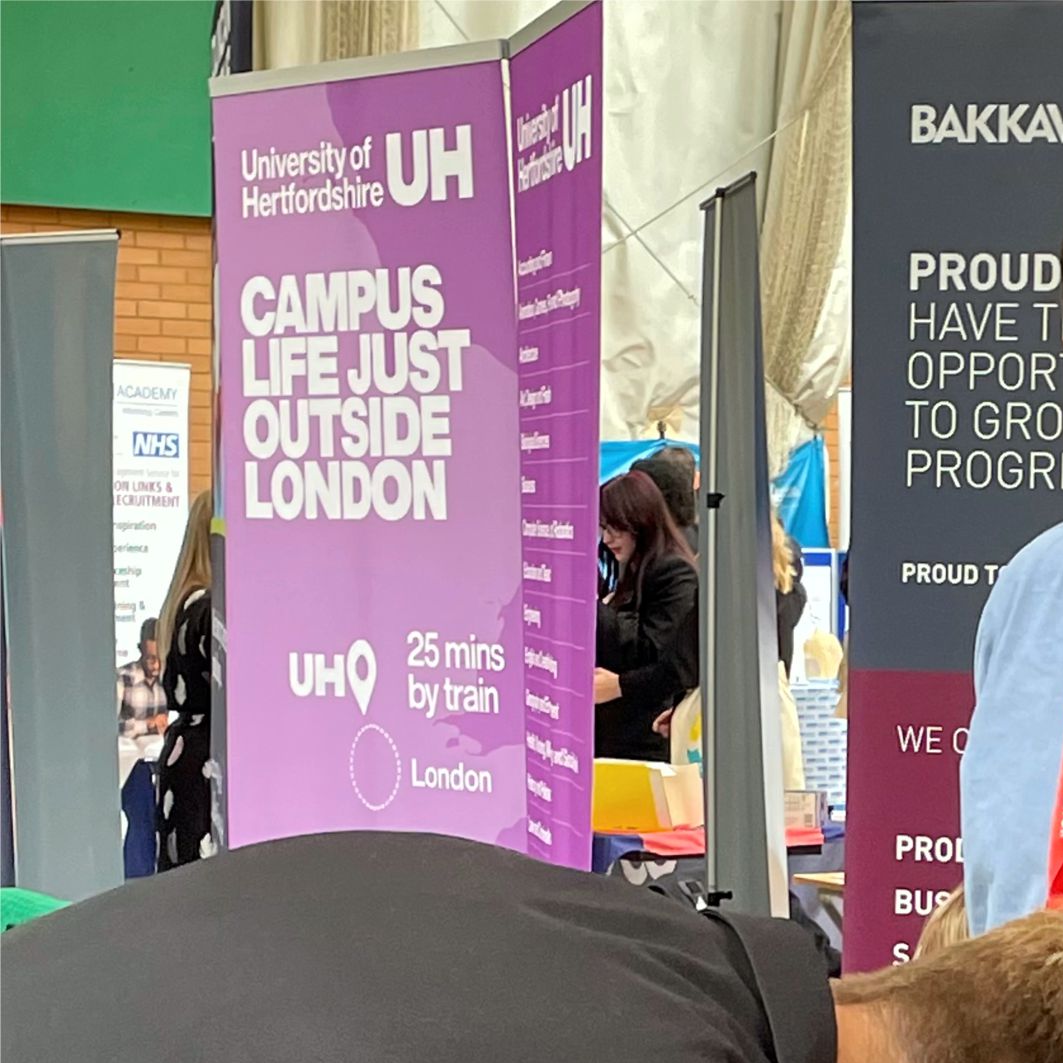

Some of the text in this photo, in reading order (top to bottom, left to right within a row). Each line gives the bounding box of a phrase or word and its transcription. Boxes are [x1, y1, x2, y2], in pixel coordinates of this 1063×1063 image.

[241, 136, 372, 181] University of
[386, 124, 474, 206] UH
[242, 177, 384, 218] Hertfordshire
[909, 253, 1062, 291] PROUD
[240, 265, 445, 337] CAMPUS
[909, 302, 1019, 341] HAVE
[242, 329, 471, 397] LIFE JUST
[116, 384, 178, 400] ACADEMY
[243, 395, 452, 459] OUTSIDE
[905, 401, 957, 439] TO
[134, 432, 178, 457] NHS
[113, 494, 180, 507] ECRUITMENT
[132, 481, 162, 493] LINKS
[245, 459, 447, 521] LONDON
[902, 563, 979, 585] PROUD
[407, 631, 440, 668] 25
[445, 634, 505, 672] mins
[408, 673, 438, 718] by
[444, 677, 499, 714] train
[897, 725, 943, 753] WE
[411, 758, 492, 793] London
